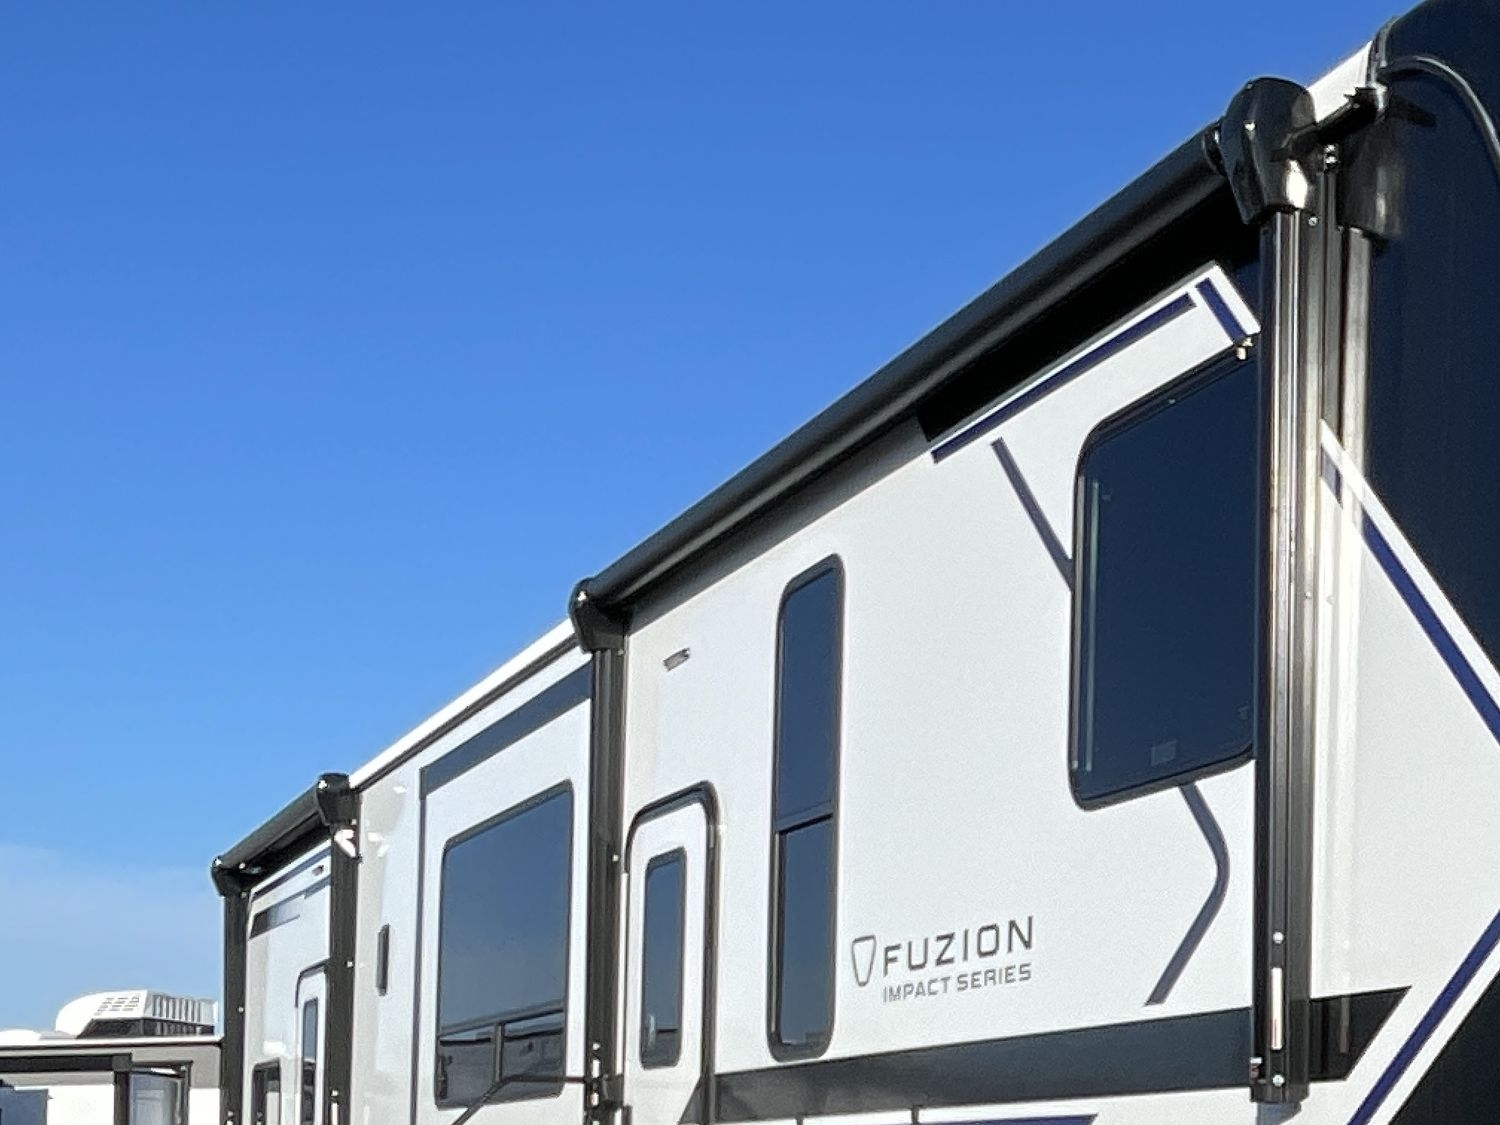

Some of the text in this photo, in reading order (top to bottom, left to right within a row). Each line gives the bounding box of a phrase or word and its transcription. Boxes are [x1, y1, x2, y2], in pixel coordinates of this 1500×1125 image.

[882, 915, 1034, 977] FUZION
[882, 962, 1033, 1003] IMPACT SERIES
